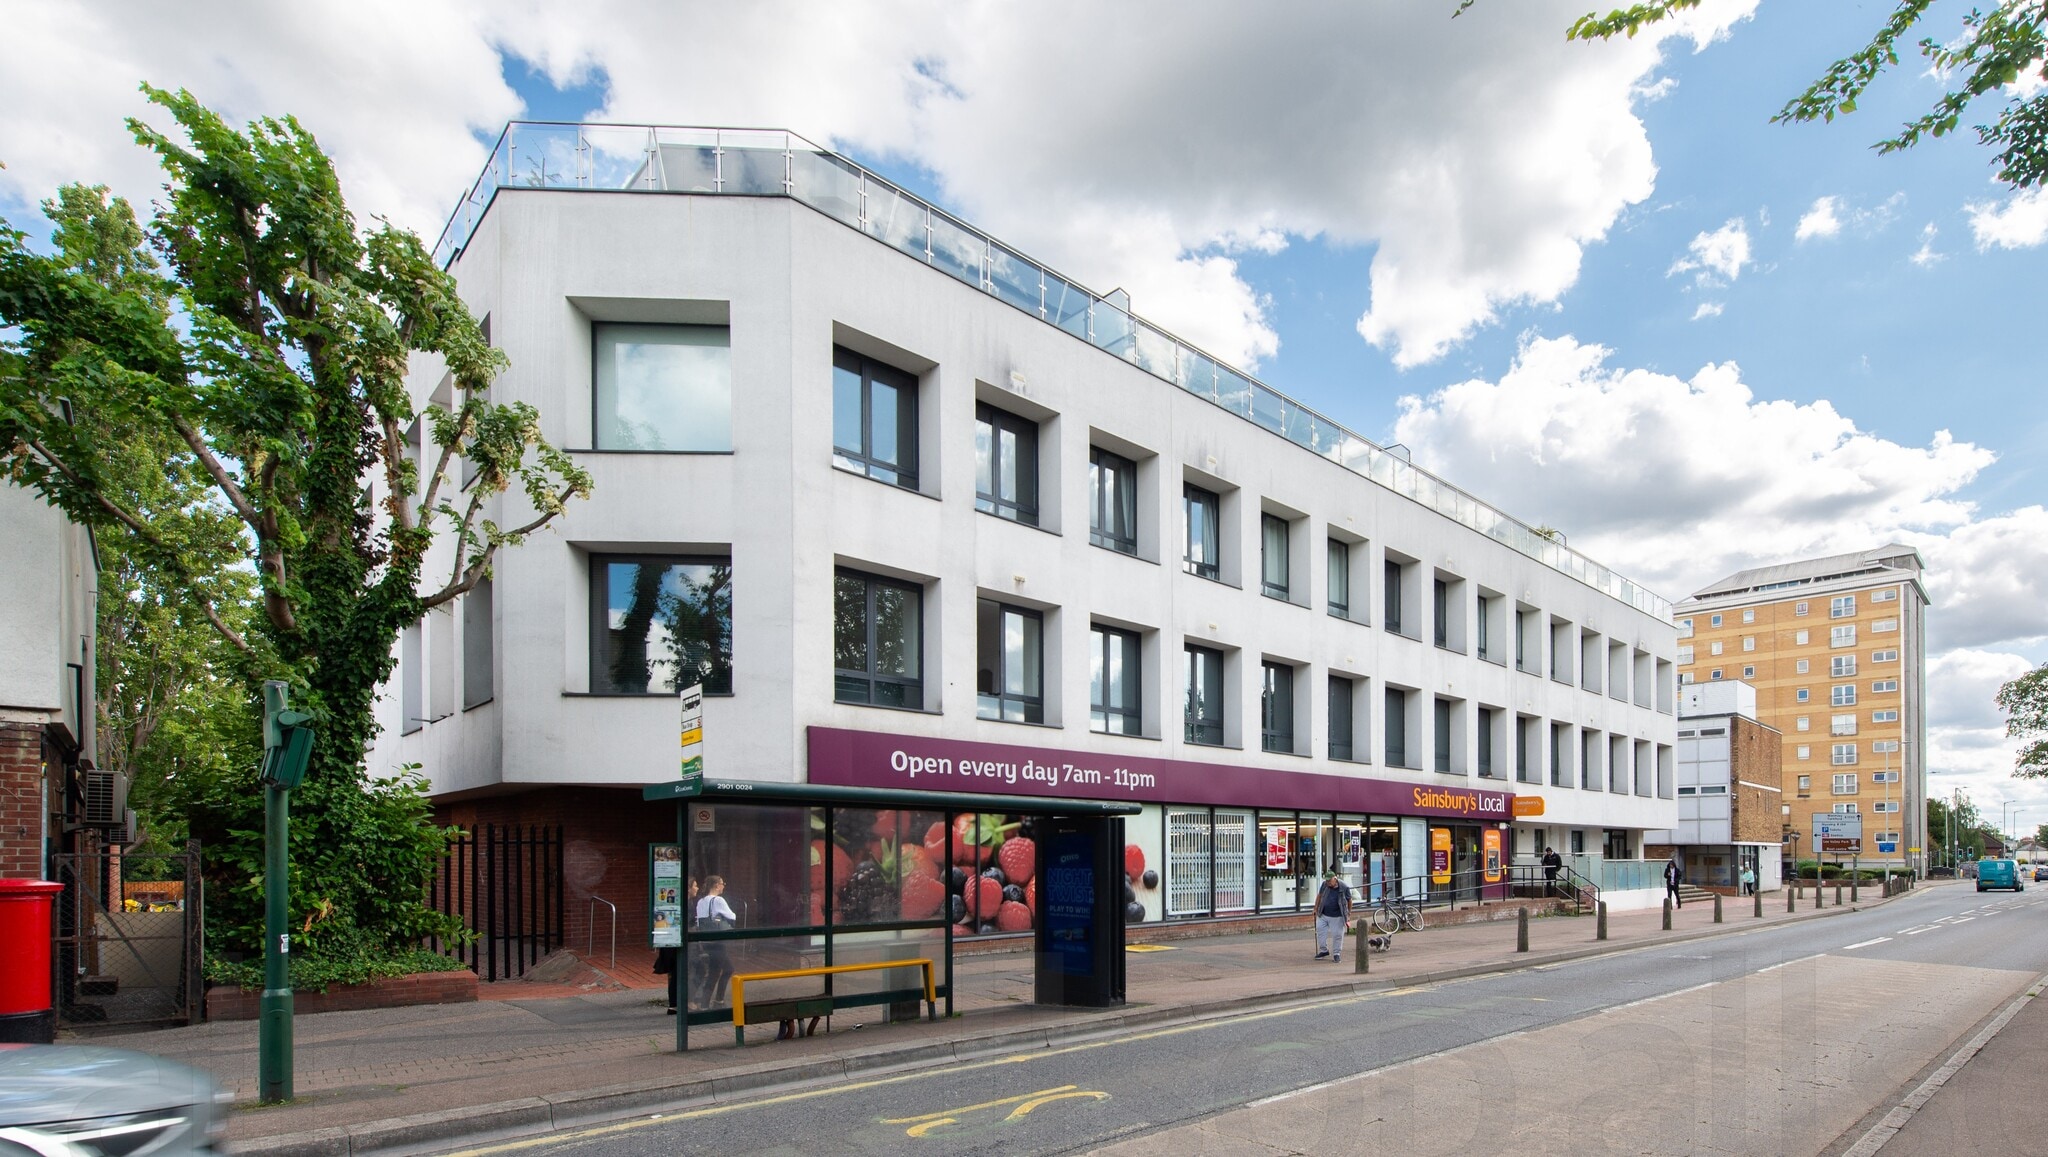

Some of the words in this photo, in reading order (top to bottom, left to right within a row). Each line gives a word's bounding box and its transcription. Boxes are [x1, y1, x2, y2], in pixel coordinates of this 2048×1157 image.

[890, 750, 952, 778] Open
[959, 759, 1017, 784] every
[1022, 760, 1058, 786] day
[1062, 764, 1101, 784] 7am
[1114, 768, 1155, 790] 11pm
[1413, 787, 1476, 814] Sainsbury's
[1478, 793, 1505, 812] Local
[1048, 868, 1092, 885] NIGHT
[1047, 885, 1092, 902] TWIST
